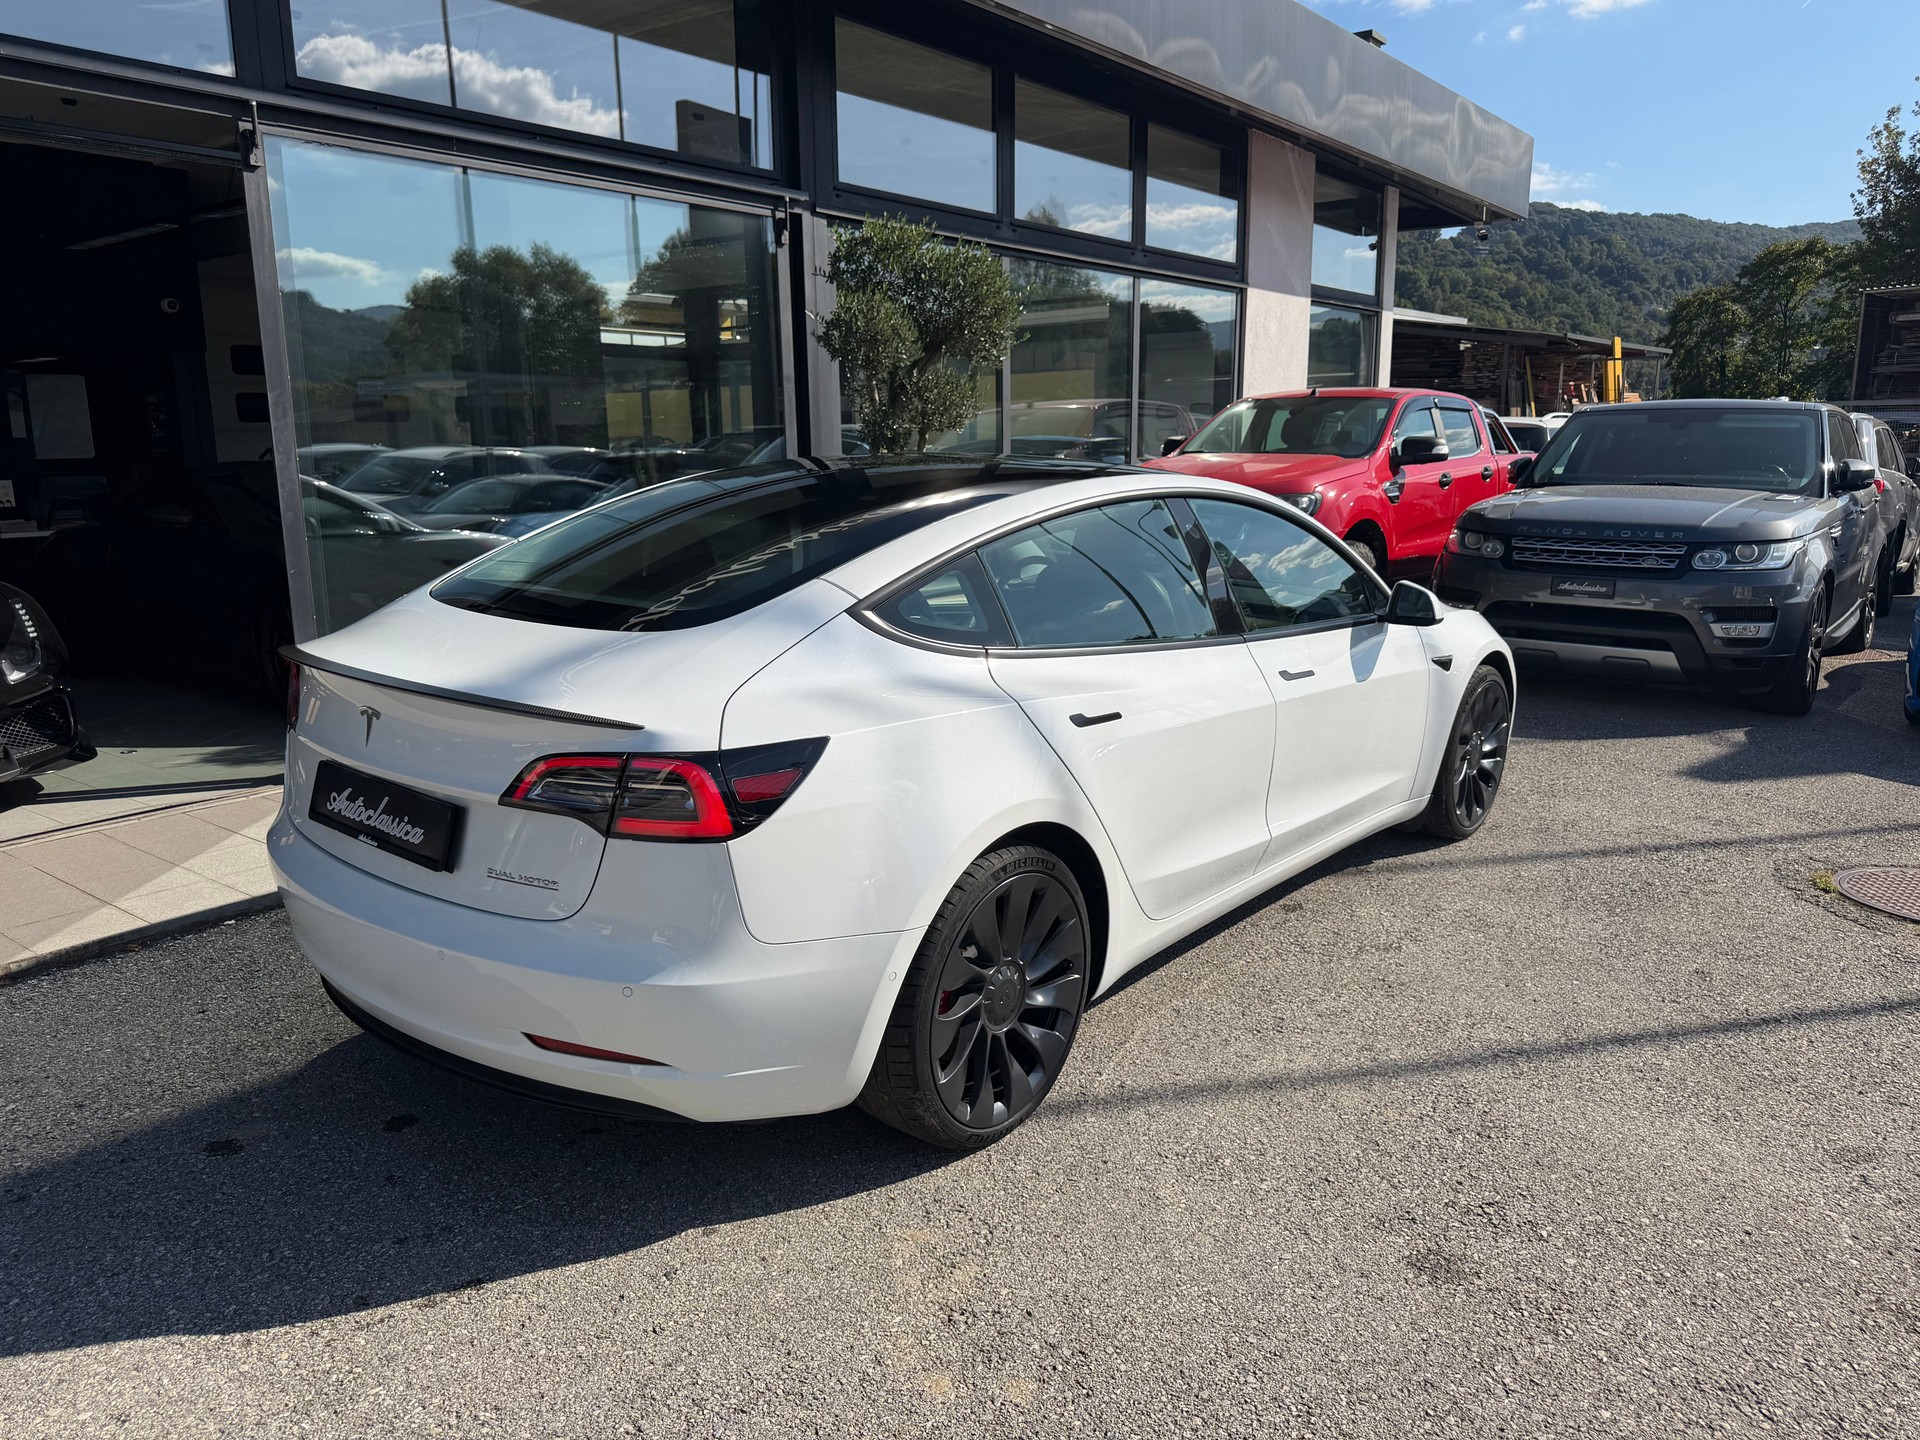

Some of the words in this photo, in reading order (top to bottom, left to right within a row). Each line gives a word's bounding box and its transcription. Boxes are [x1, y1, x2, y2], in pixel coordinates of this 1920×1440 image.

[1603, 530, 1684, 539] ROVER
[326, 787, 425, 845] Autoclassica
[1006, 857, 1055, 872] MICHELIN
[487, 867, 516, 880] DUAL
[518, 874, 560, 888] MOTOR
